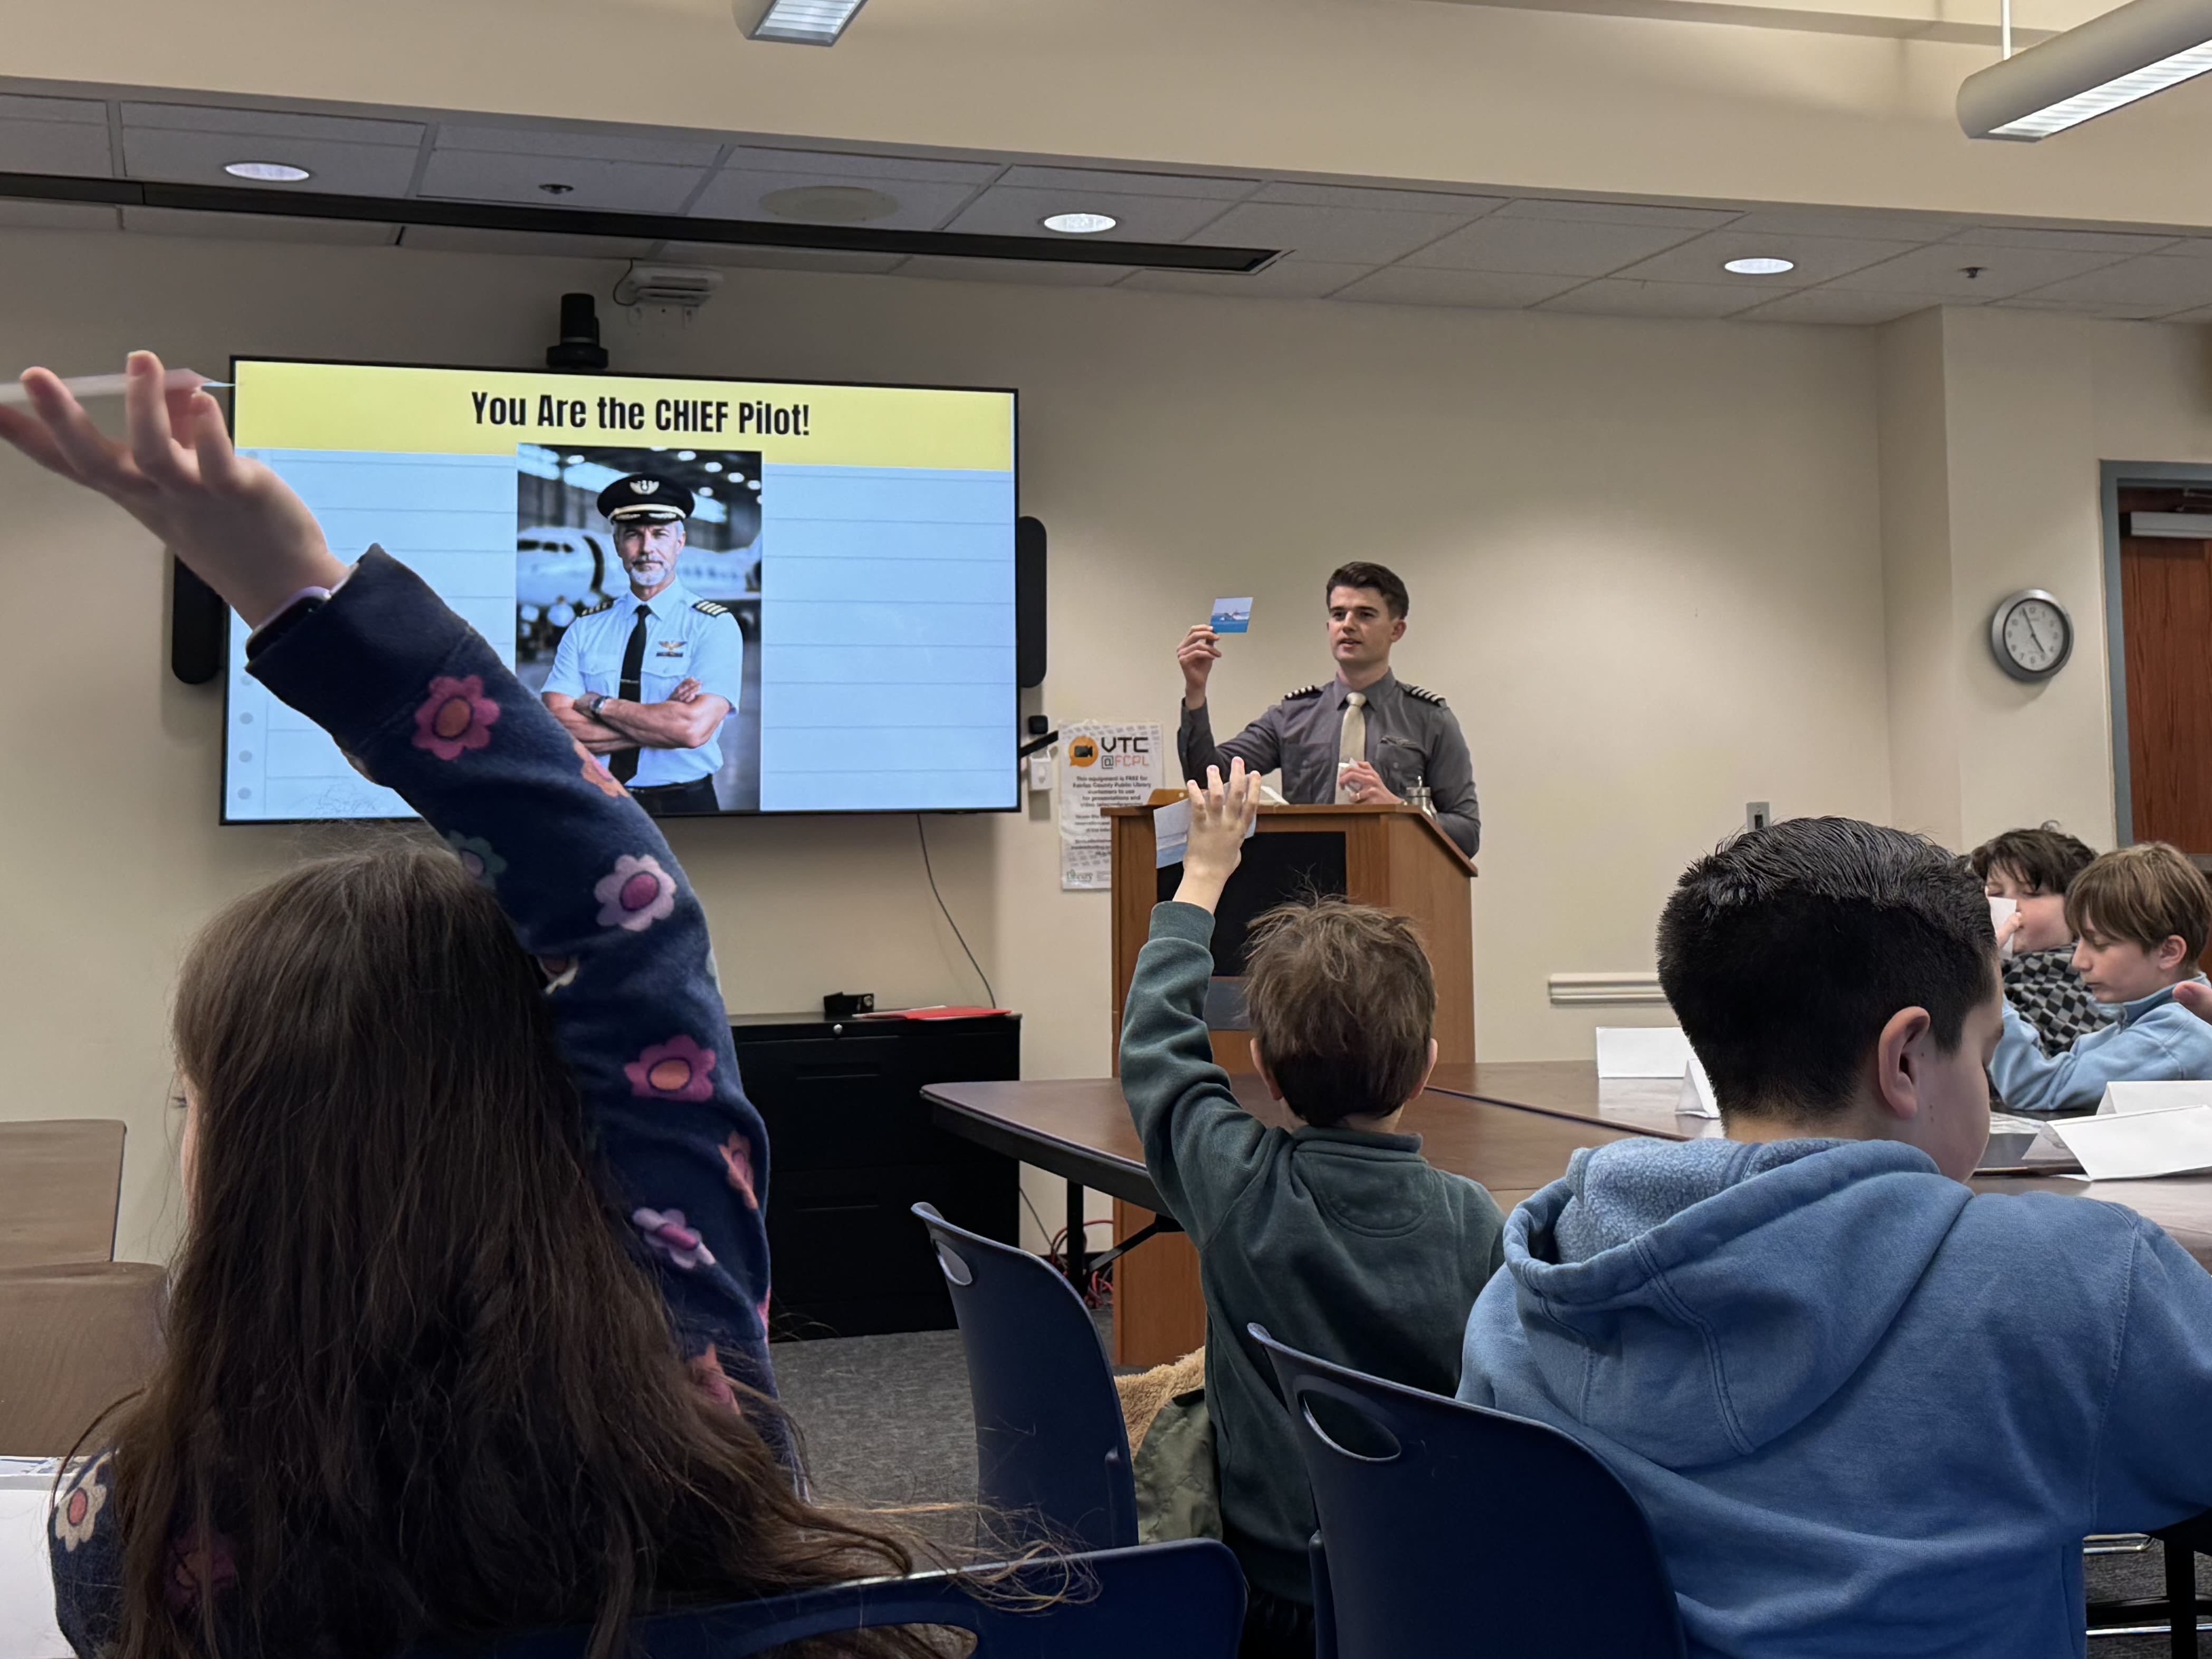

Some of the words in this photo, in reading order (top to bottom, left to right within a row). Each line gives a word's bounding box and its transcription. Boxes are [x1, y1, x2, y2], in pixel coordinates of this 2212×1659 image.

[472, 391, 527, 426] You
[537, 394, 587, 428] Are
[597, 396, 645, 430] the
[655, 398, 729, 433] CHIEF
[739, 401, 810, 436] Pilot!
[1101, 736, 1149, 754] VTC
[1101, 755, 1150, 769] @FCPL
